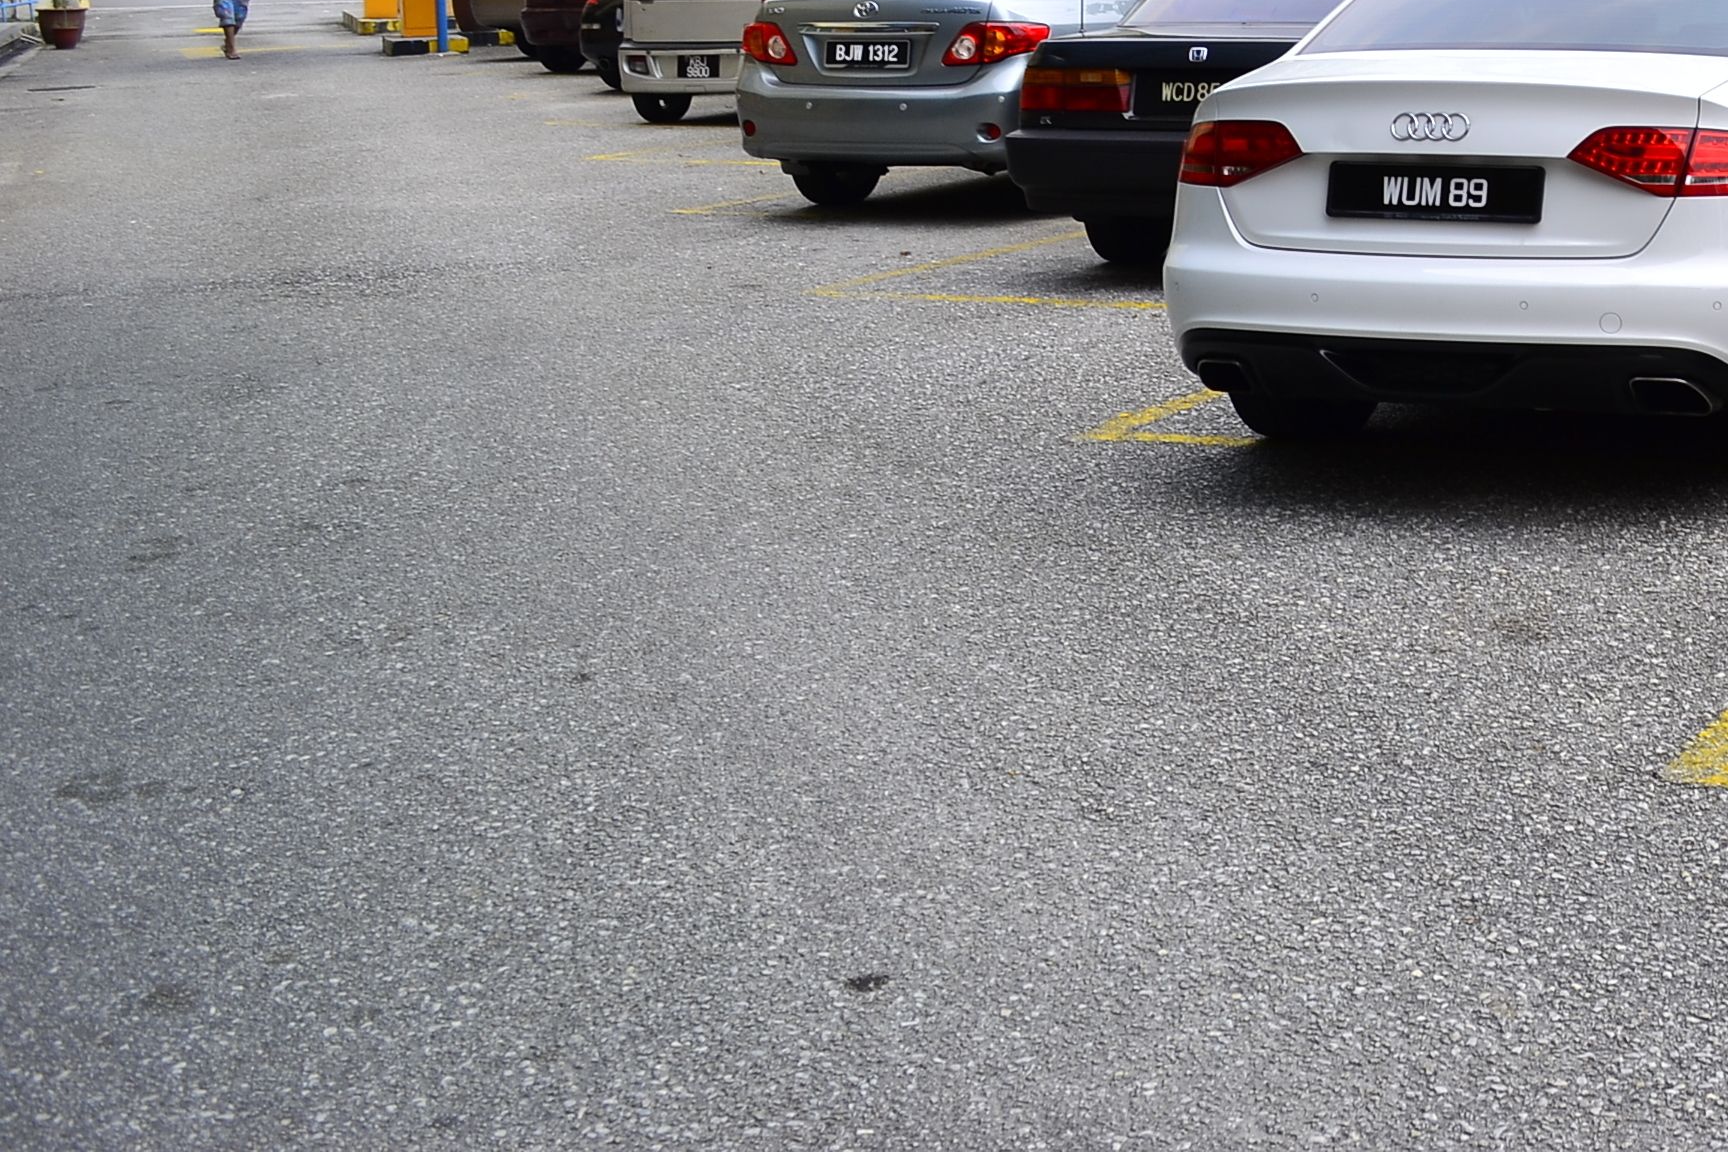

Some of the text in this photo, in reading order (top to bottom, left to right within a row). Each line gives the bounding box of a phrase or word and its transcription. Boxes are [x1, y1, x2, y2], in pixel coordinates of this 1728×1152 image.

[835, 44, 899, 62] BJW 1312
[1162, 82, 1195, 102] WCD
[1383, 176, 1488, 208] WUM 89
